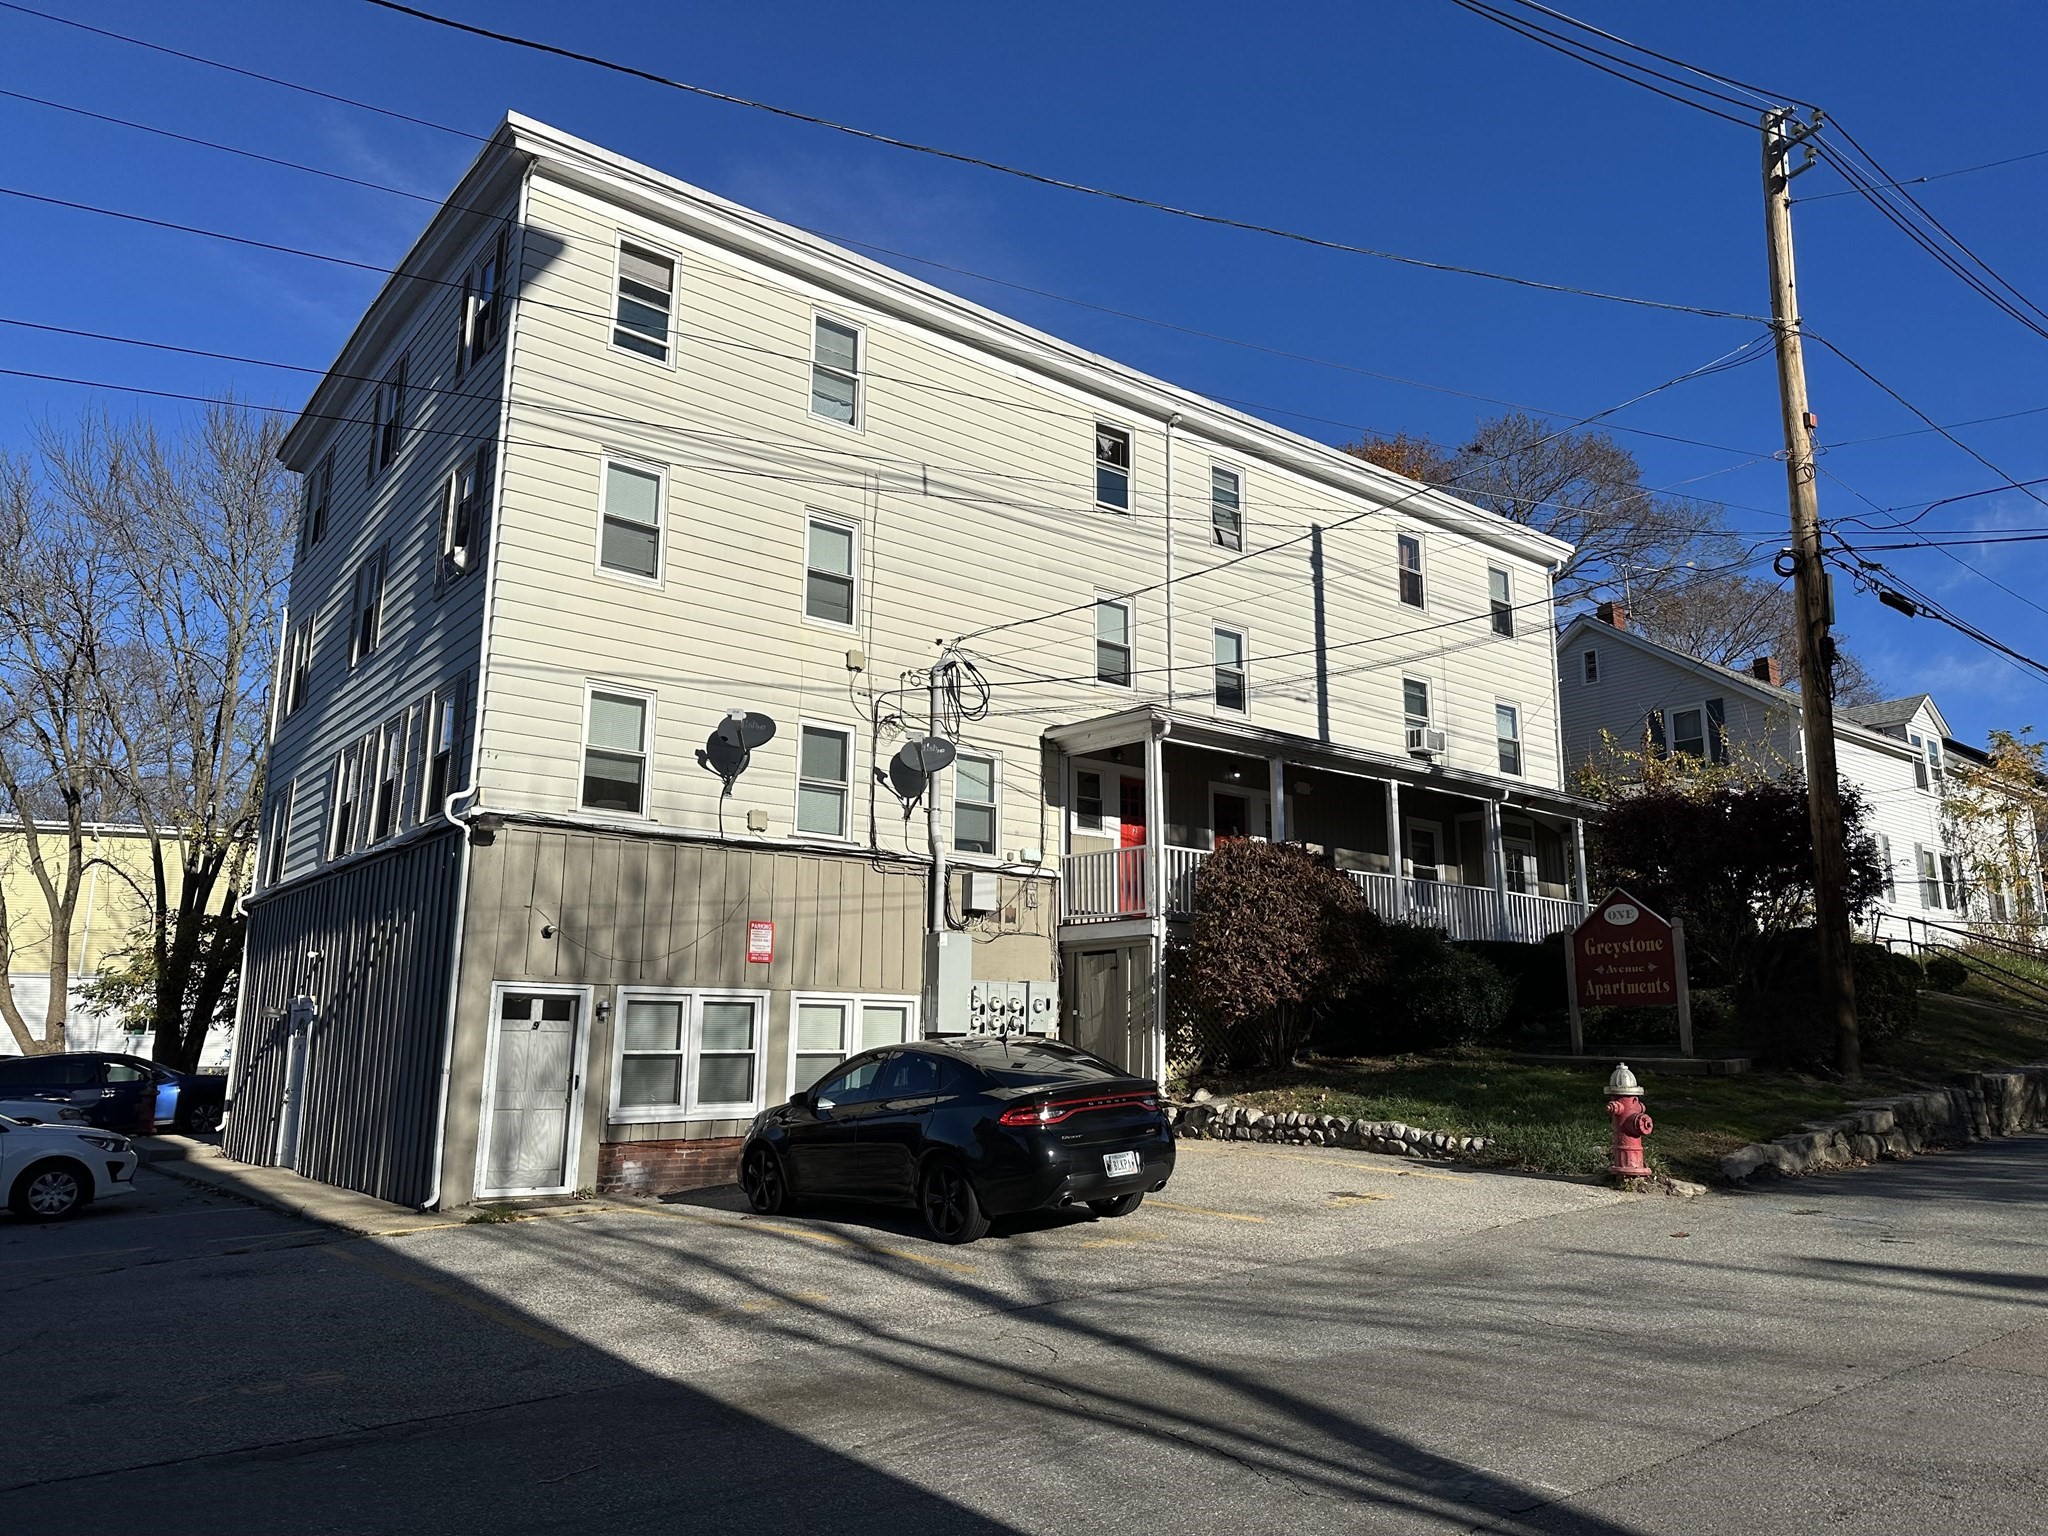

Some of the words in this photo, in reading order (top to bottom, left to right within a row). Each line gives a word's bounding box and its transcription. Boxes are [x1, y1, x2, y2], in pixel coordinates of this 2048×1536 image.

[1607, 909, 1635, 920] ONE
[1584, 936, 1664, 959] Greystone
[1606, 964, 1645, 974] Avenue
[1585, 976, 1671, 1001] Apartments
[533, 1021, 540, 1030] 9
